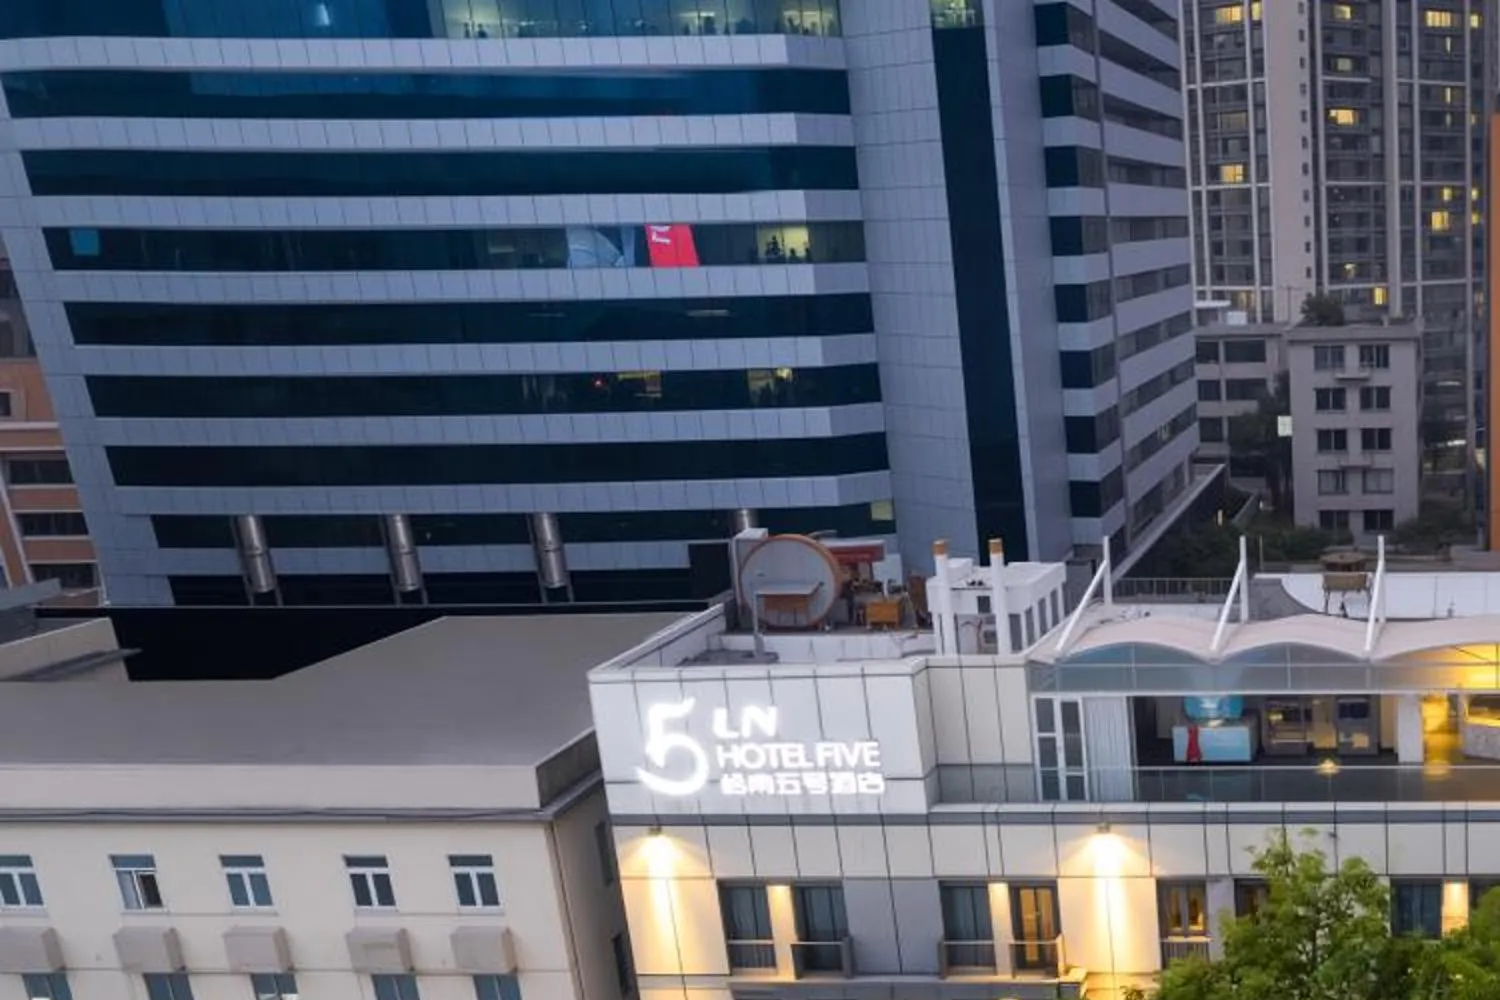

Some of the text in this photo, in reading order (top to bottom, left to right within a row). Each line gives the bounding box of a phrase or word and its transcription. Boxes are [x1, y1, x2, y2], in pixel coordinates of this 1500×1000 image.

[712, 705, 777, 738] LN
[635, 696, 709, 796] 5
[716, 741, 881, 769] HOTEL FIVE
